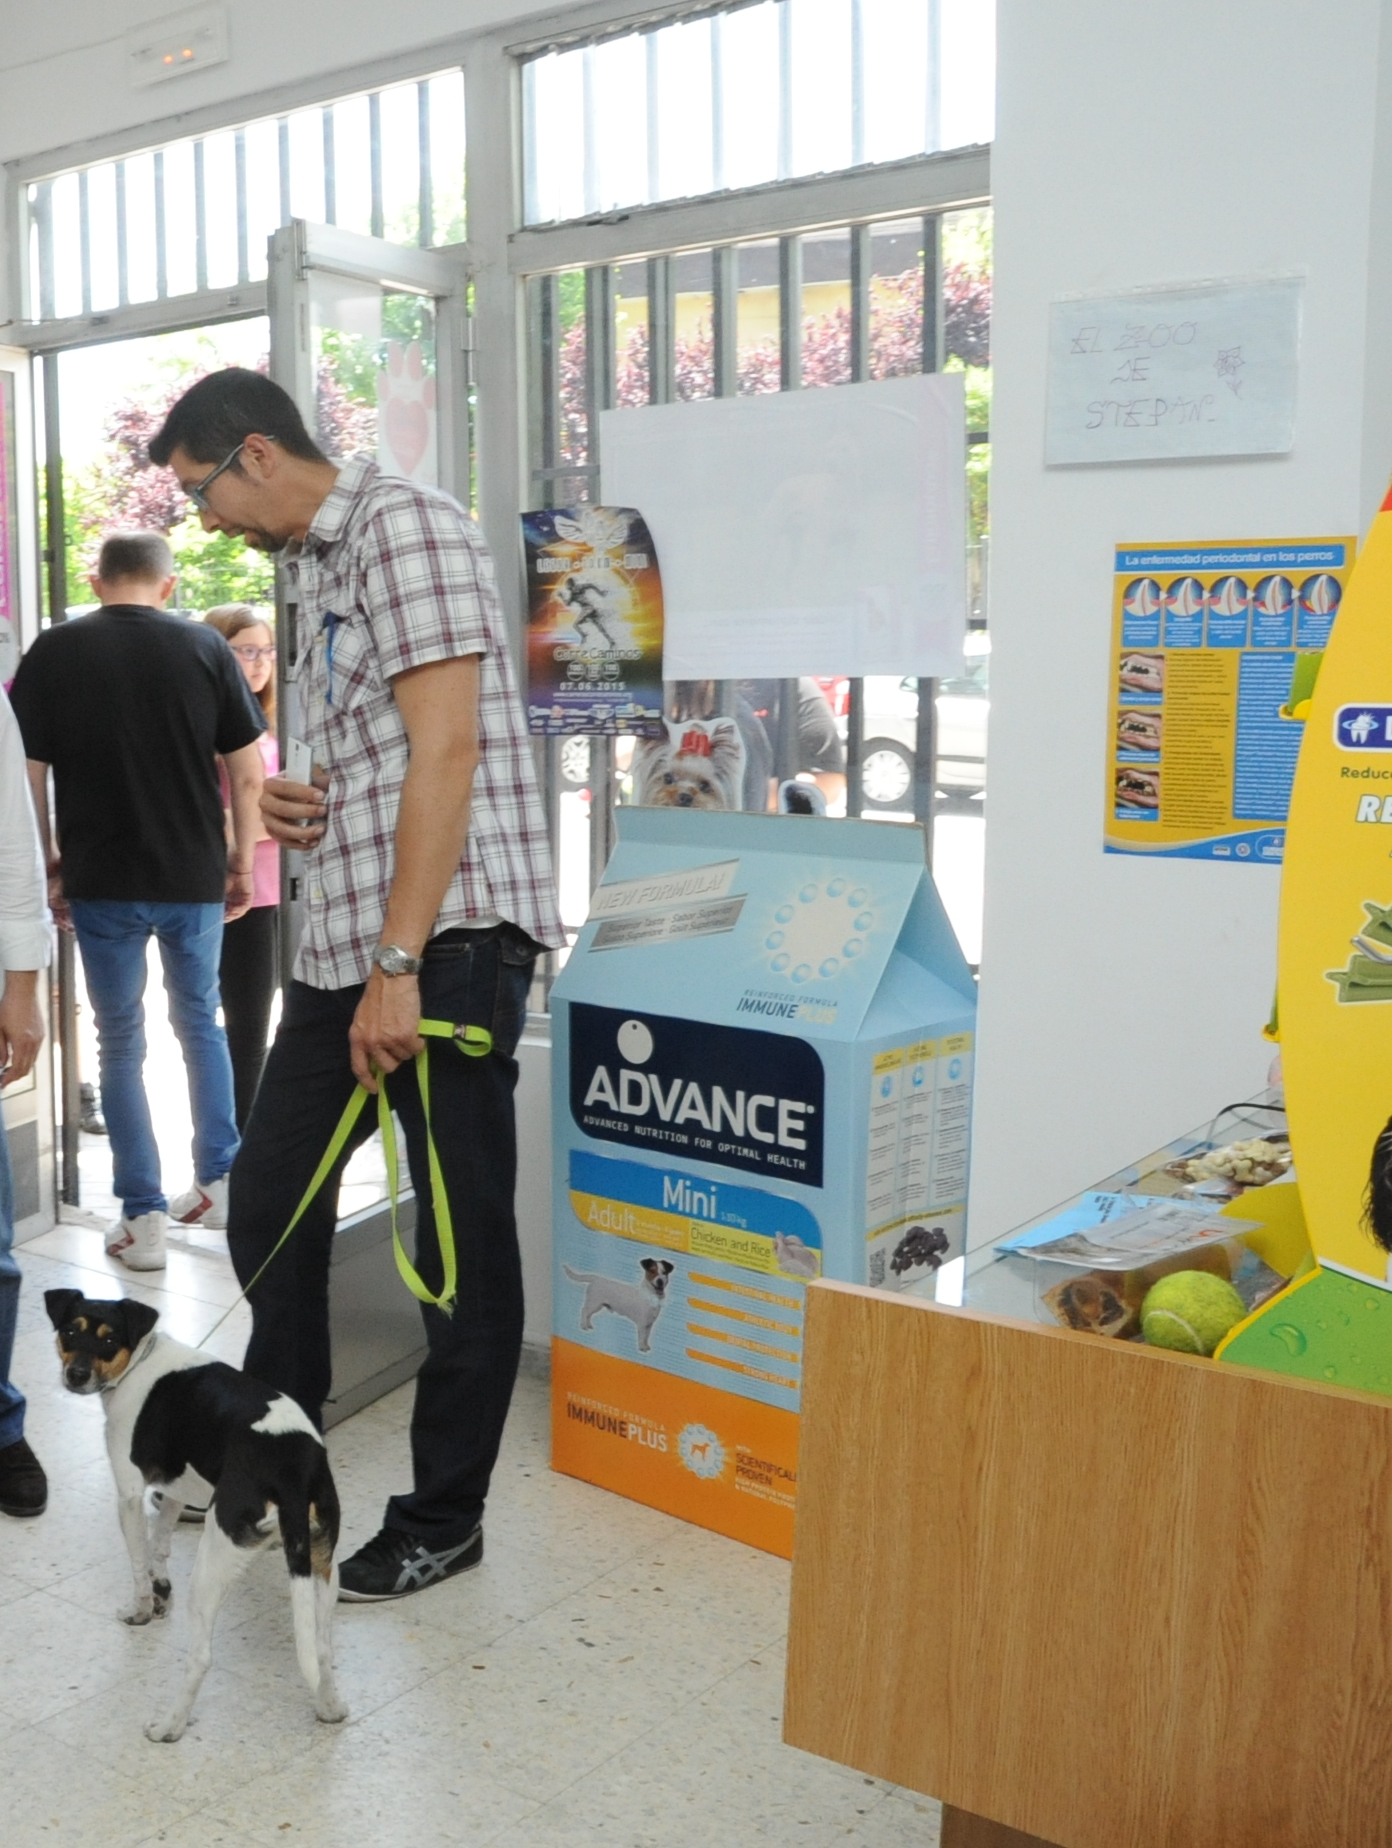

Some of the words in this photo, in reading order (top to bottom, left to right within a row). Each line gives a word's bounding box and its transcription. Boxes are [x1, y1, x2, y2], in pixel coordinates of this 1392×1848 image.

[1071, 326, 1103, 354] EL
[1113, 321, 1198, 351] ZOO
[1125, 555, 1140, 565] La
[1141, 554, 1201, 565] enfermedad
[1202, 552, 1261, 566] periodontal
[1263, 554, 1277, 562] en
[1279, 552, 1296, 562] los
[1297, 552, 1334, 563] perros
[560, 682, 626, 691] 07.06.2015
[597, 888, 638, 910] NEW
[638, 873, 726, 905] FORMULA!
[744, 989, 795, 1002] REINFORCED
[798, 995, 838, 1007] FORMULA
[583, 1065, 806, 1150] ADVANCE
[583, 1115, 629, 1132] ADVANCED
[634, 1125, 689, 1144] NUTRITION
[694, 1137, 712, 1149] FOR
[718, 1141, 761, 1161] OPTIMAL
[767, 1153, 806, 1170] HEALTH
[663, 1175, 717, 1219] Mini
[587, 1201, 636, 1234] Adult
[691, 1227, 728, 1247] Chicken
[730, 1238, 749, 1252] and
[751, 1241, 771, 1258] Rice
[567, 1392, 620, 1416] REINFORCED
[623, 1410, 665, 1431] FORMULA
[736, 1466, 773, 1486] PROVEN
